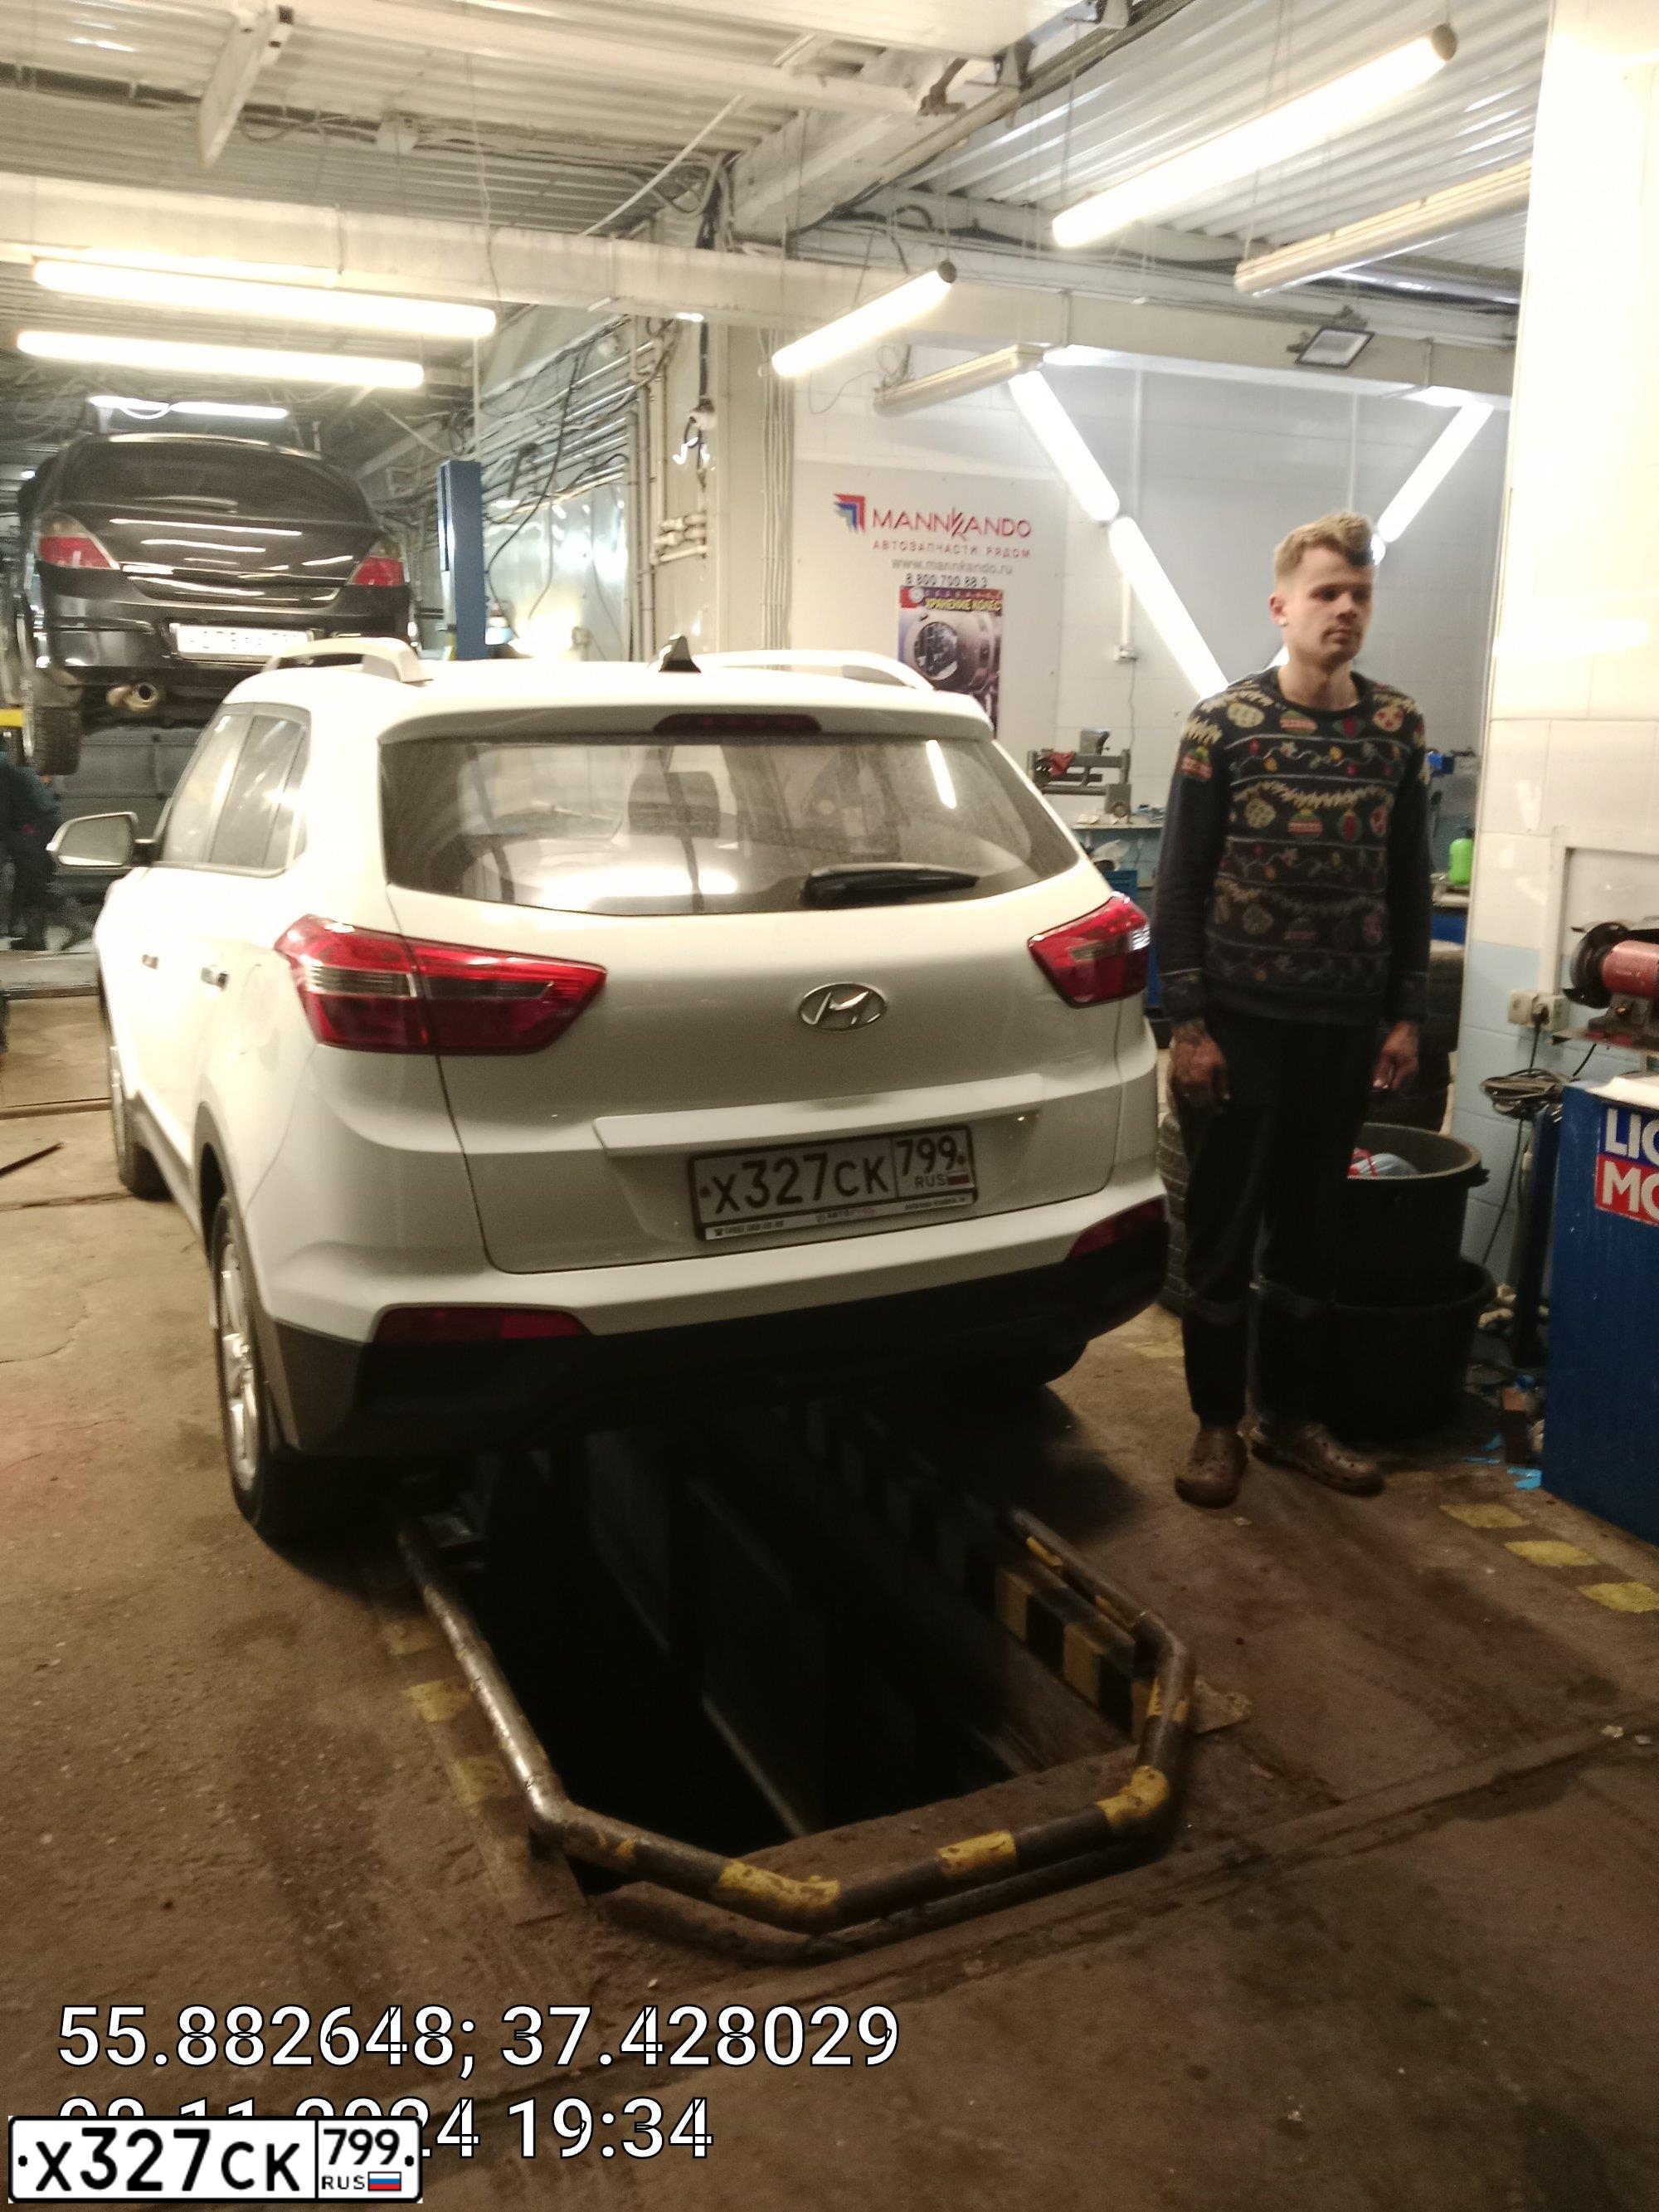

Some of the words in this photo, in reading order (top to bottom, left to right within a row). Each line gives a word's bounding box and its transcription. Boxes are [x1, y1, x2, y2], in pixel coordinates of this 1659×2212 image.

[872, 507, 1032, 540] MANNKANDO
[873, 540, 978, 554] АВТОЗАПЧАСТИ
[985, 547, 1030, 558] РЯДОМ
[896, 1135, 958, 1177] 799
[914, 1172, 946, 1189] RUS
